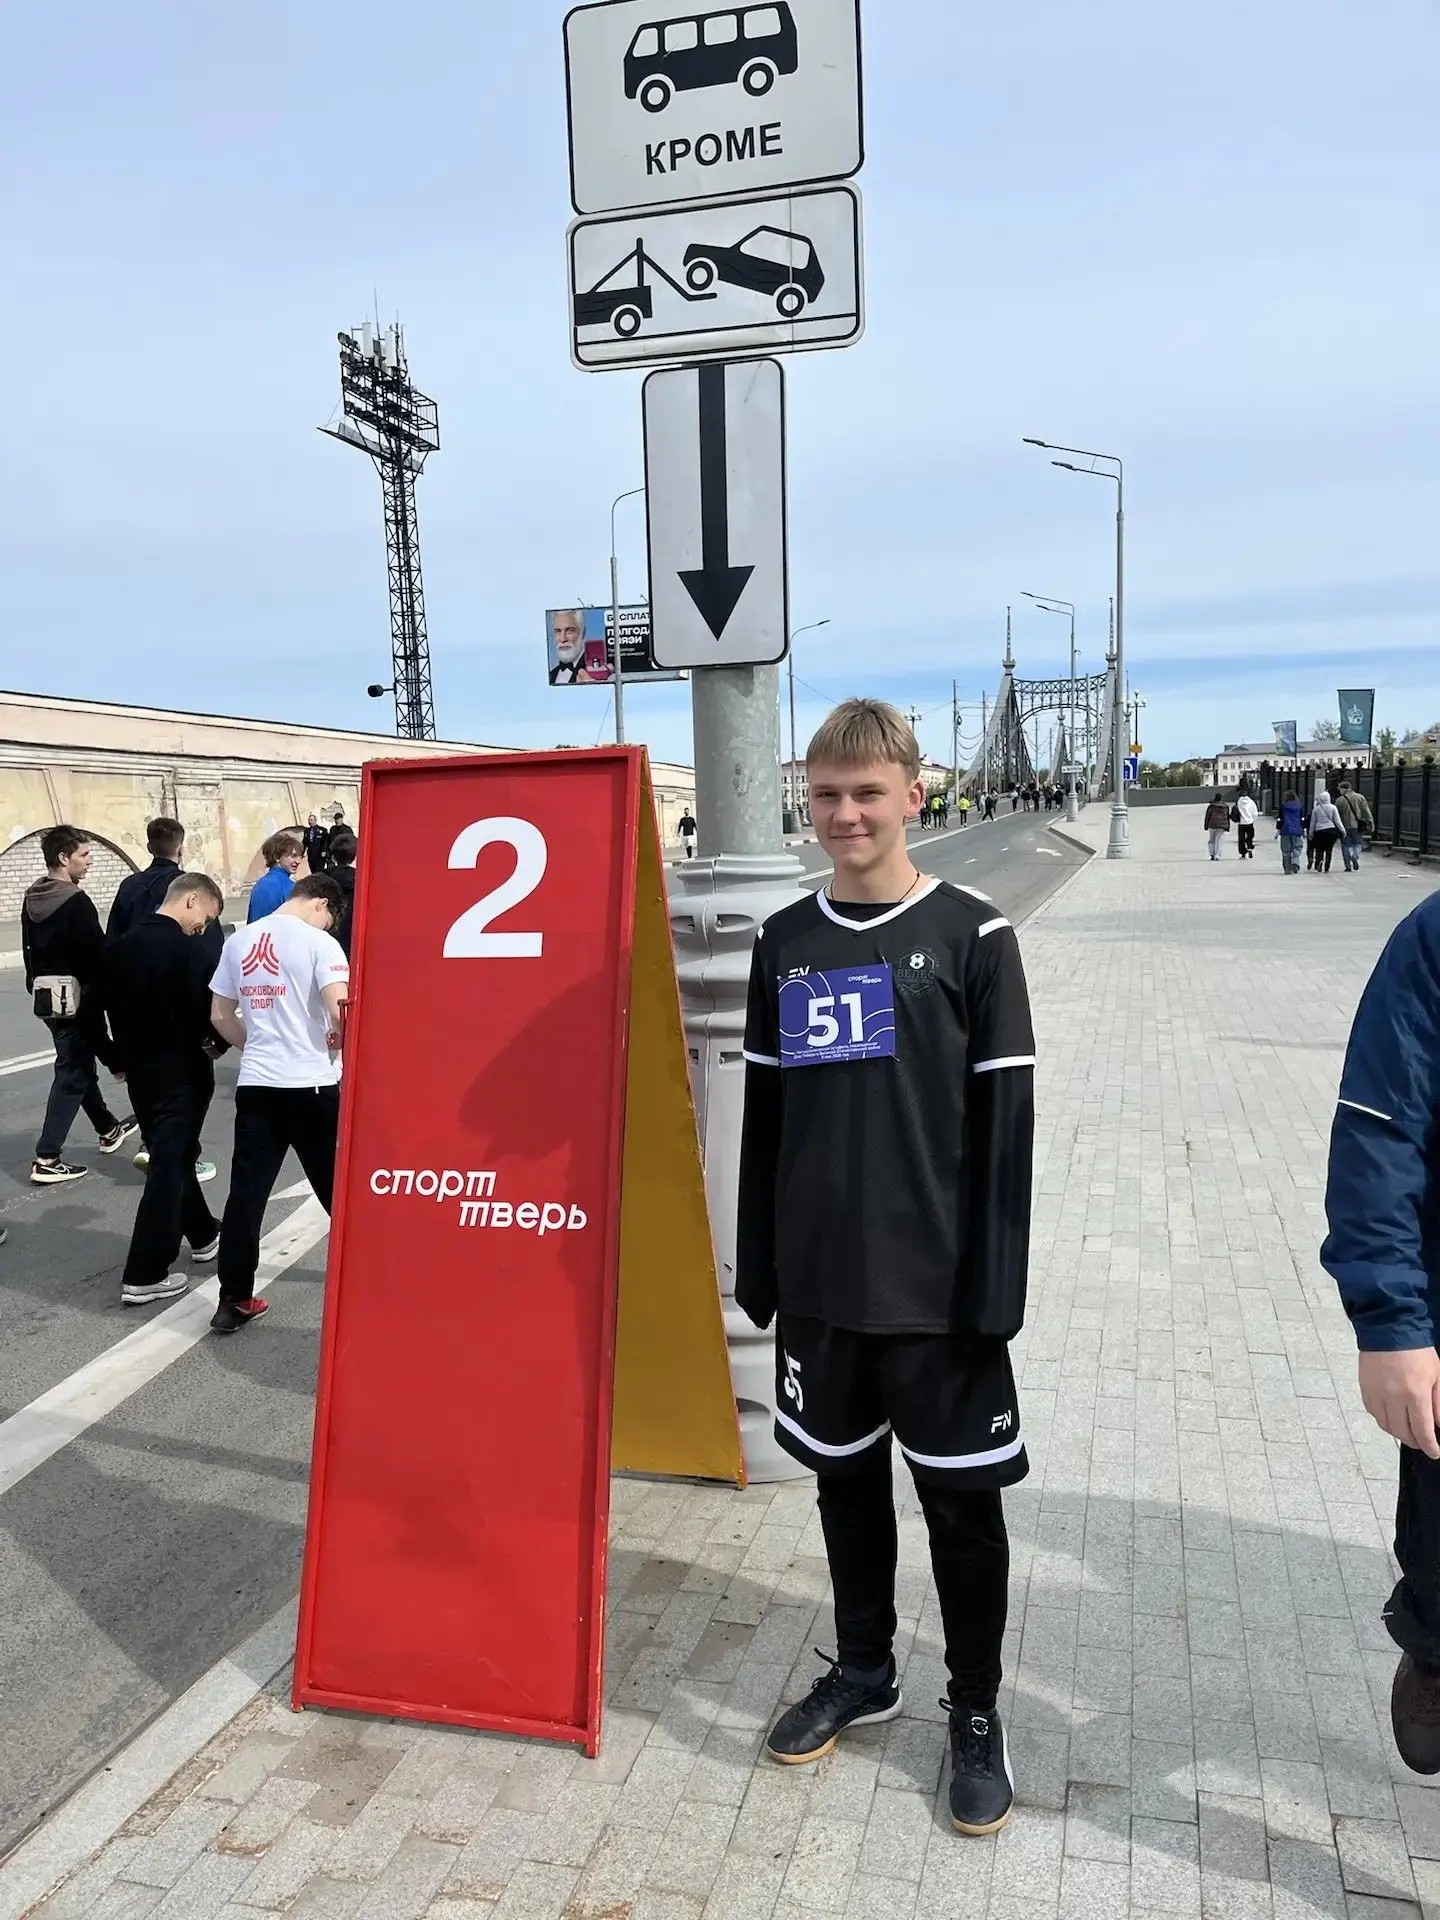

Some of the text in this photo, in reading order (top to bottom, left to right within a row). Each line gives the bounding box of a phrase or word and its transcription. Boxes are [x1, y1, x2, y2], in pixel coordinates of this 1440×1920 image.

[645, 121, 783, 176] КРОМЕ
[607, 626, 650, 637] ПЛГОД
[607, 635, 643, 645] СЯЗИ
[442, 816, 548, 959] 2
[250, 998, 274, 1010] СПОРТ
[806, 992, 864, 1047] 51
[369, 1168, 497, 1203] спорт
[458, 1201, 588, 1236] тверь
[990, 1409, 1012, 1434] FN
